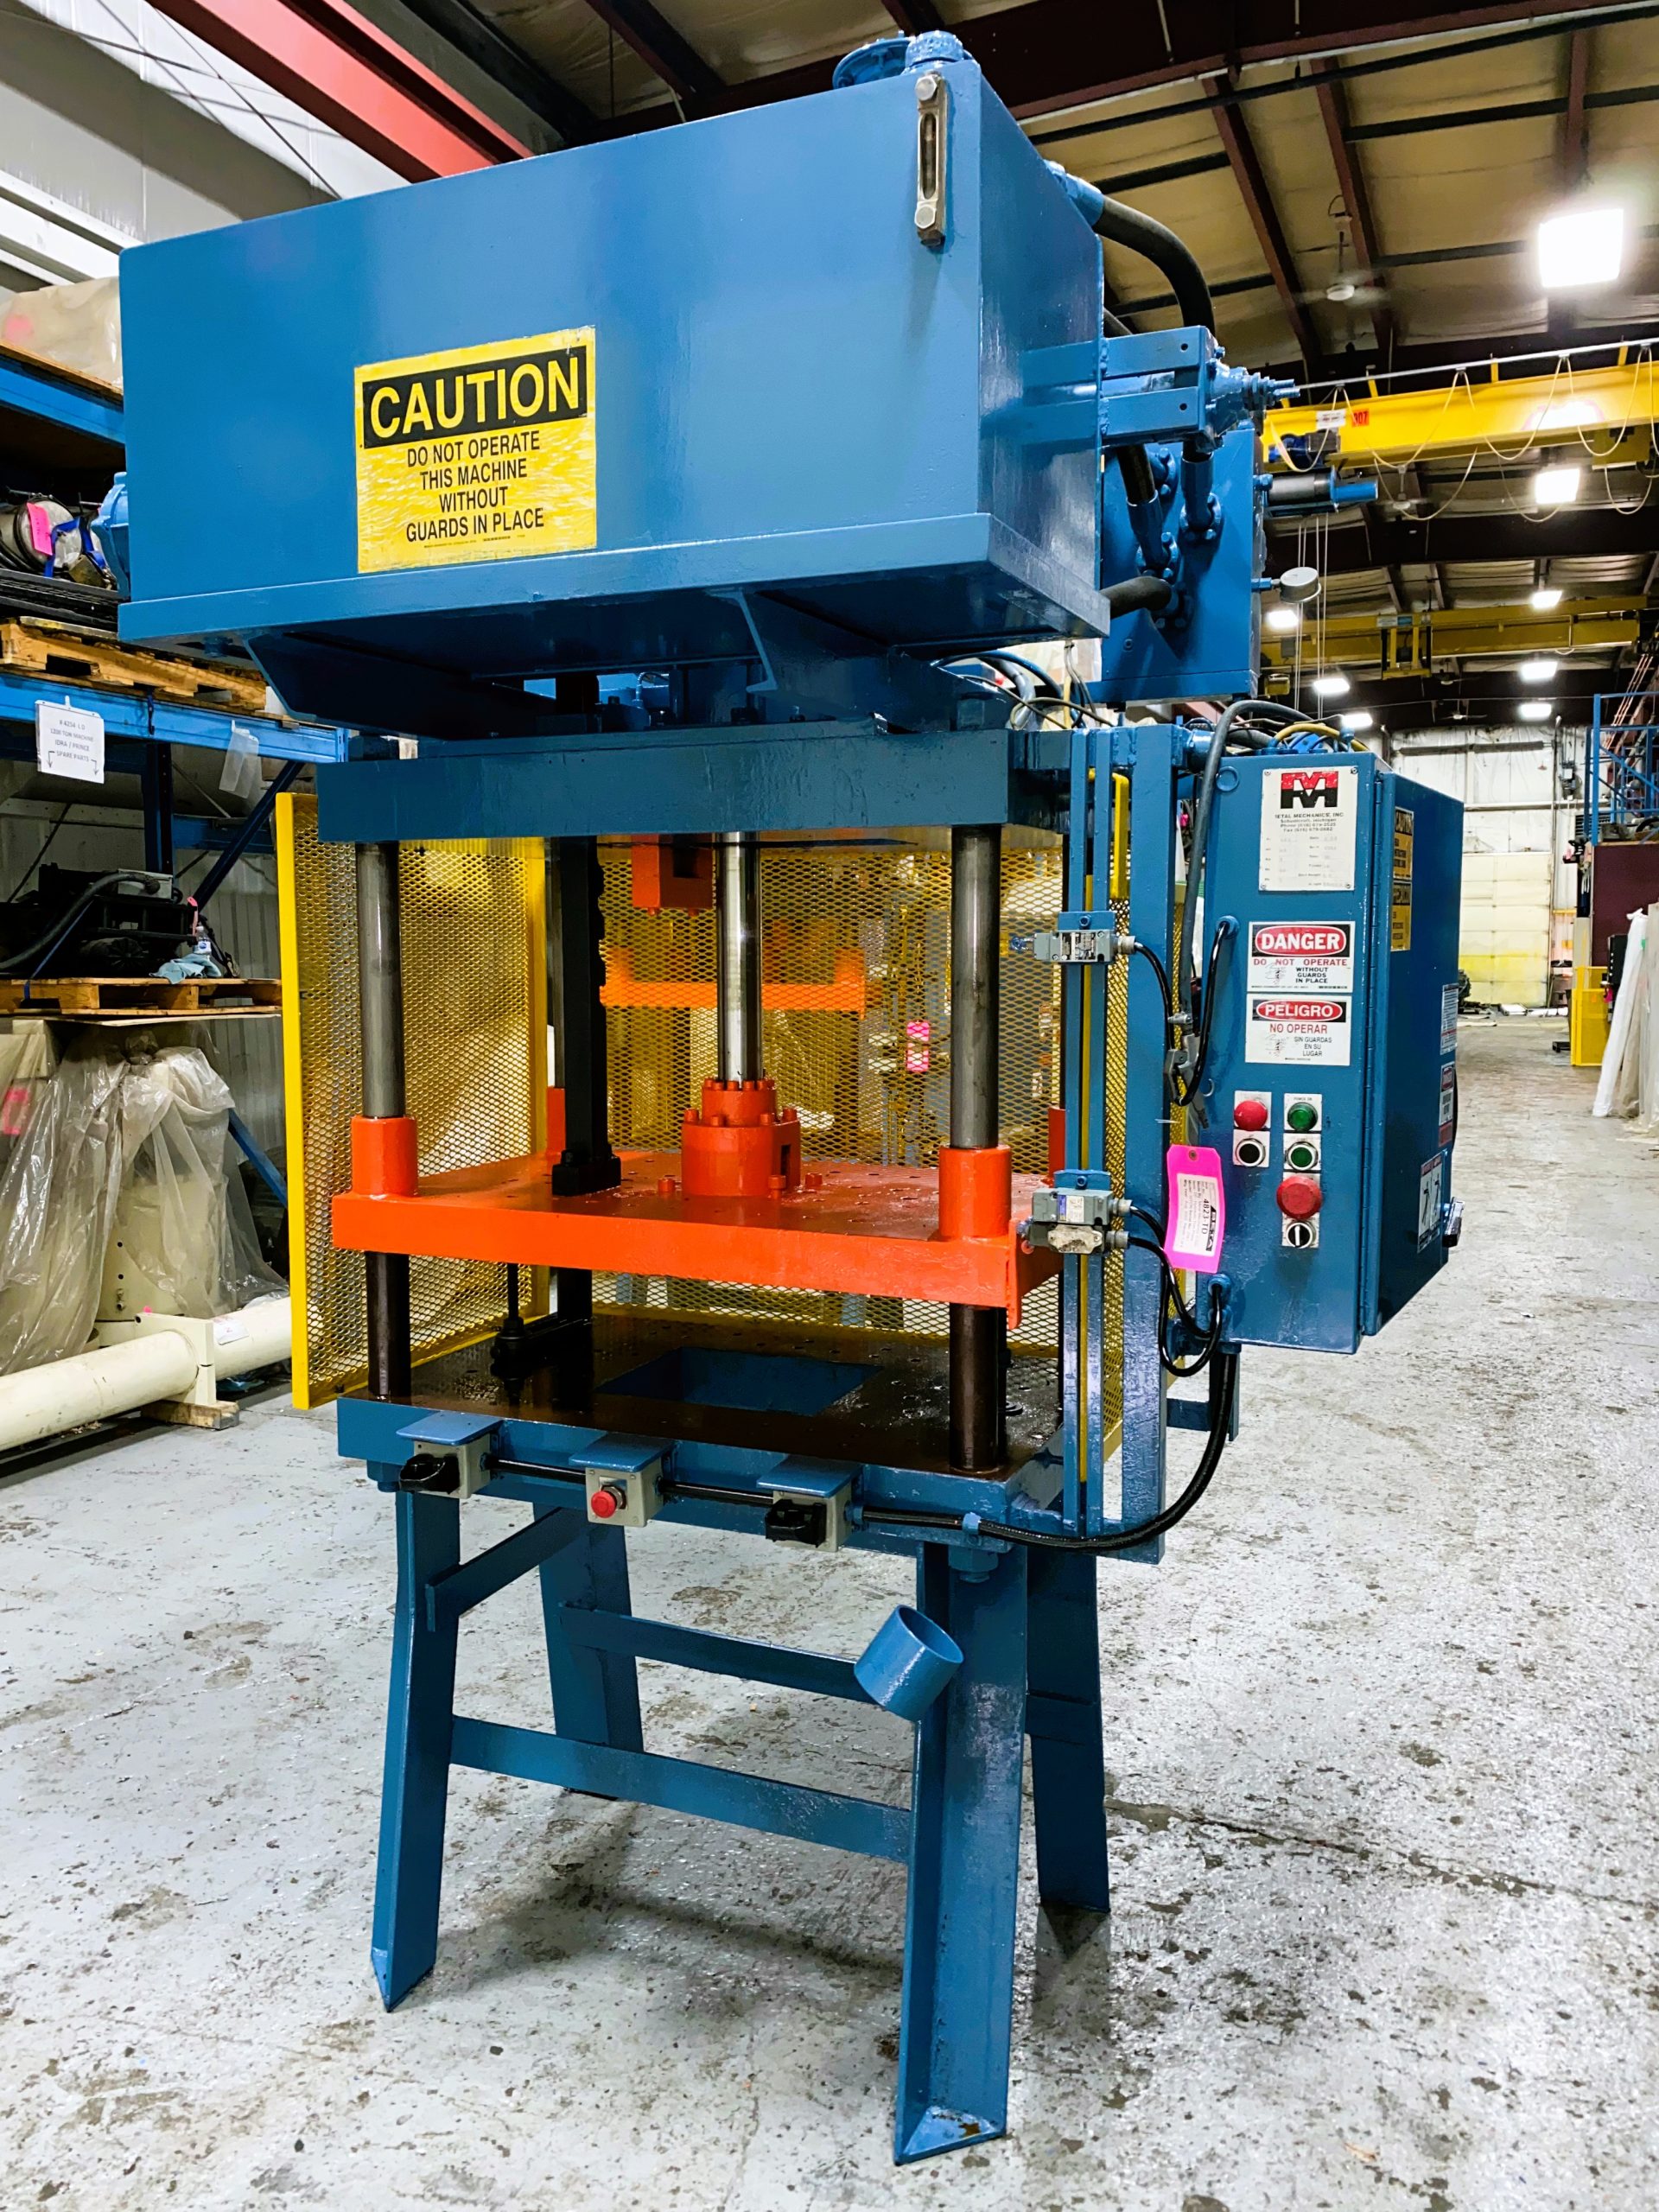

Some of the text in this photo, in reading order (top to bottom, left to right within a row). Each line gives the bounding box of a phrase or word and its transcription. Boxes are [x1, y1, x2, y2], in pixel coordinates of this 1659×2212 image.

[370, 356, 579, 439] CAUTION
[407, 430, 540, 467] DO NOT OPERATE
[420, 458, 527, 490] THIS MACHINE
[439, 486, 508, 513] WITHOUT
[406, 516, 468, 542] GUARDS
[474, 514, 487, 534] IN
[493, 507, 544, 532] PLACE
[1262, 932, 1340, 950] DANGER
[1264, 1004, 1333, 1018] PELIGRO
[1269, 1023, 1328, 1034] NO OPERAR
